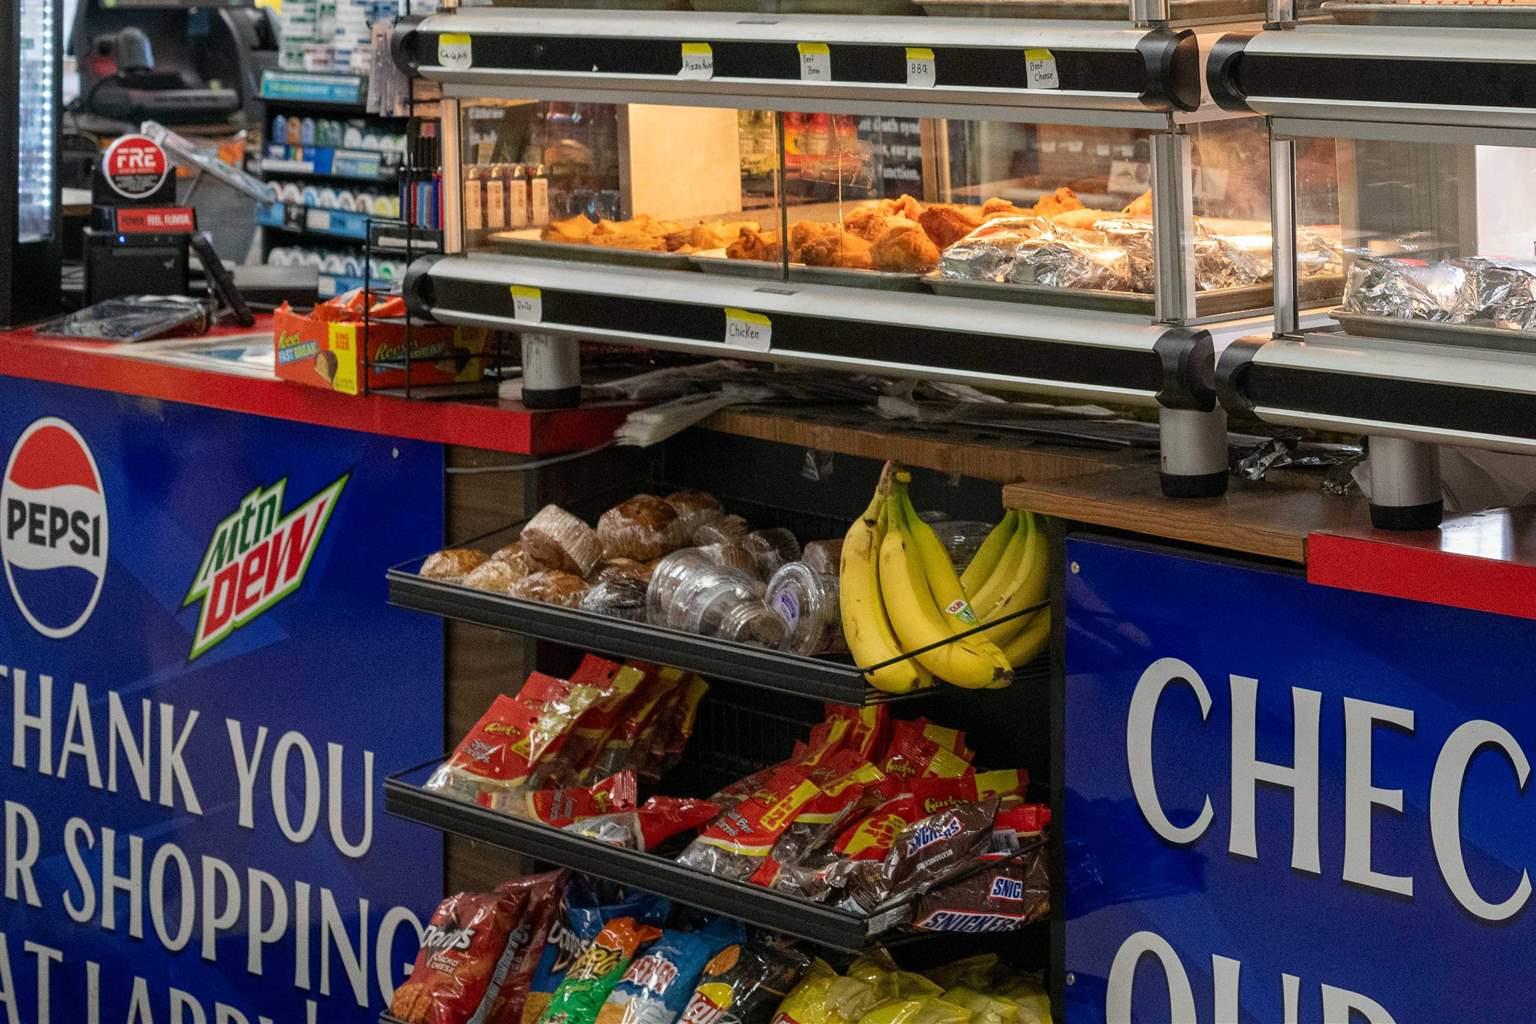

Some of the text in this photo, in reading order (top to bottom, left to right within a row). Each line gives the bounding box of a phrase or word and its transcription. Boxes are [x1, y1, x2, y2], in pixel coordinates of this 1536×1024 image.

[910, 63, 929, 75] BBQ
[116, 147, 157, 169] FRE
[729, 323, 760, 340] Chicken
[6, 498, 102, 558] PEPSI
[225, 717, 375, 858] YOU
[908, 818, 962, 856] SNICKERS
[62, 817, 424, 1011] SHOPPING
[422, 924, 475, 951] Doritos
